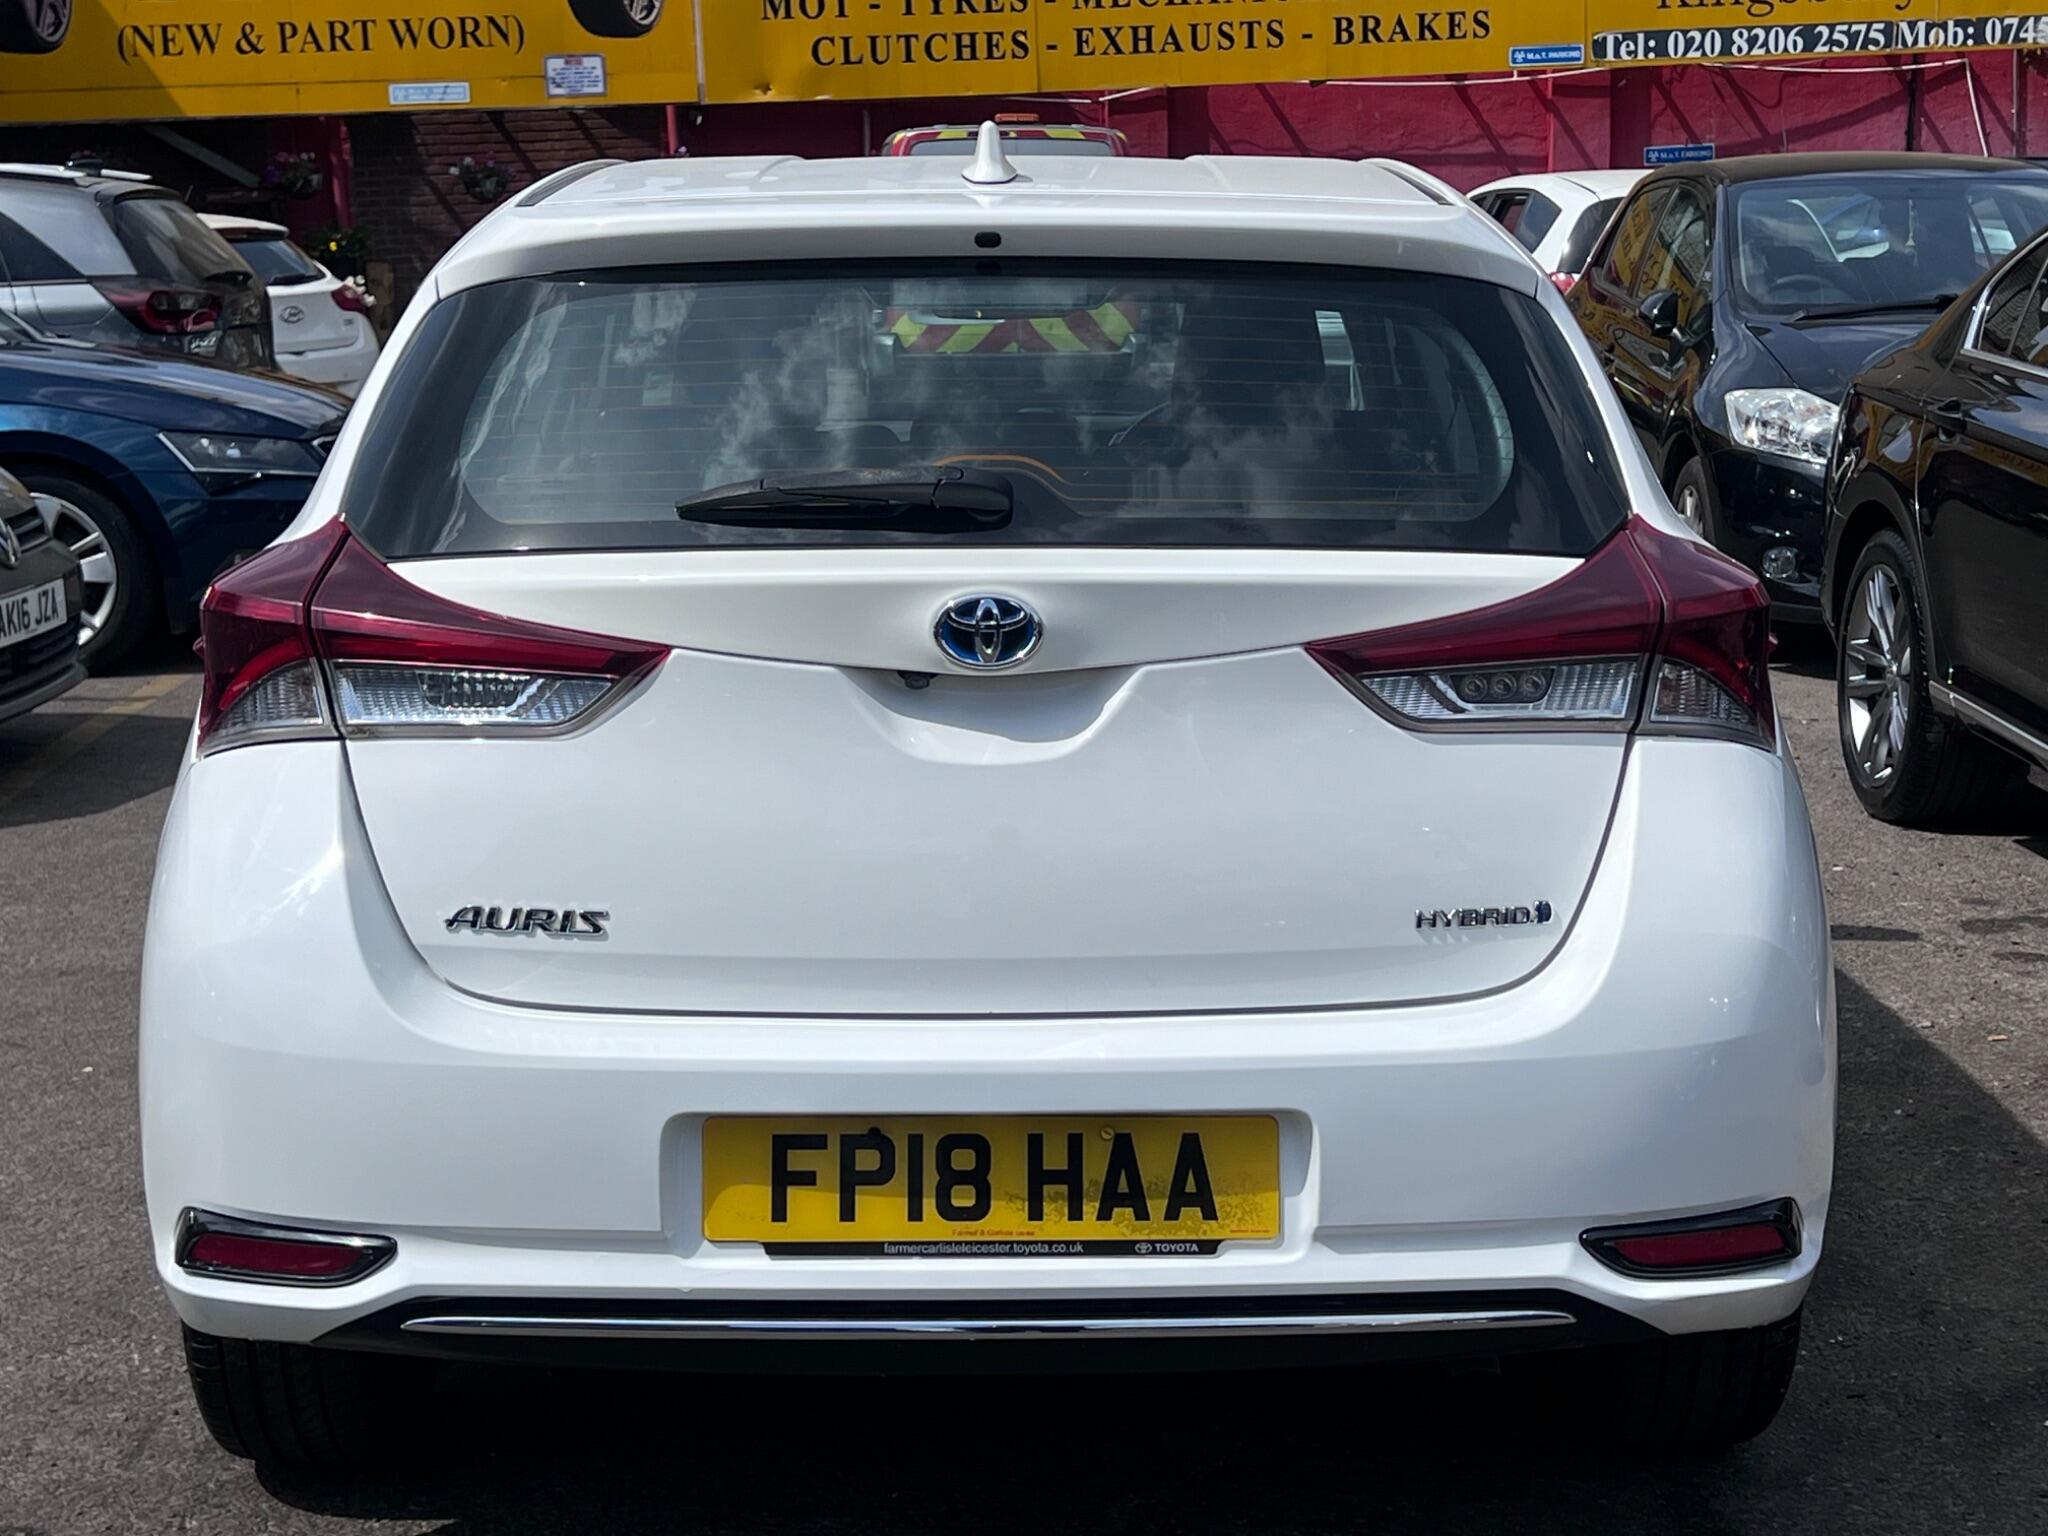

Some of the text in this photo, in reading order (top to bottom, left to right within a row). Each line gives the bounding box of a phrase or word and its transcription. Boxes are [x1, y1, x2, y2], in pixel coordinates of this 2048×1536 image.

[116, 15, 525, 66] (NEW & PART WORN)
[811, 30, 1030, 66] CLUTCHES
[1073, 19, 1285, 56] EXHAUSTS
[1333, 9, 1491, 45] BRAKES
[1598, 32, 1656, 60] Tel:
[1667, 28, 1722, 58] 020
[1731, 25, 1804, 56] 8206
[1813, 22, 1886, 53] 2575
[1898, 19, 1974, 49] Mob:
[35, 587, 59, 625] JZA
[445, 904, 609, 937] AURIS
[771, 1132, 1219, 1222] FP18 HAA
[1155, 1243, 1199, 1253] TOYOTA
